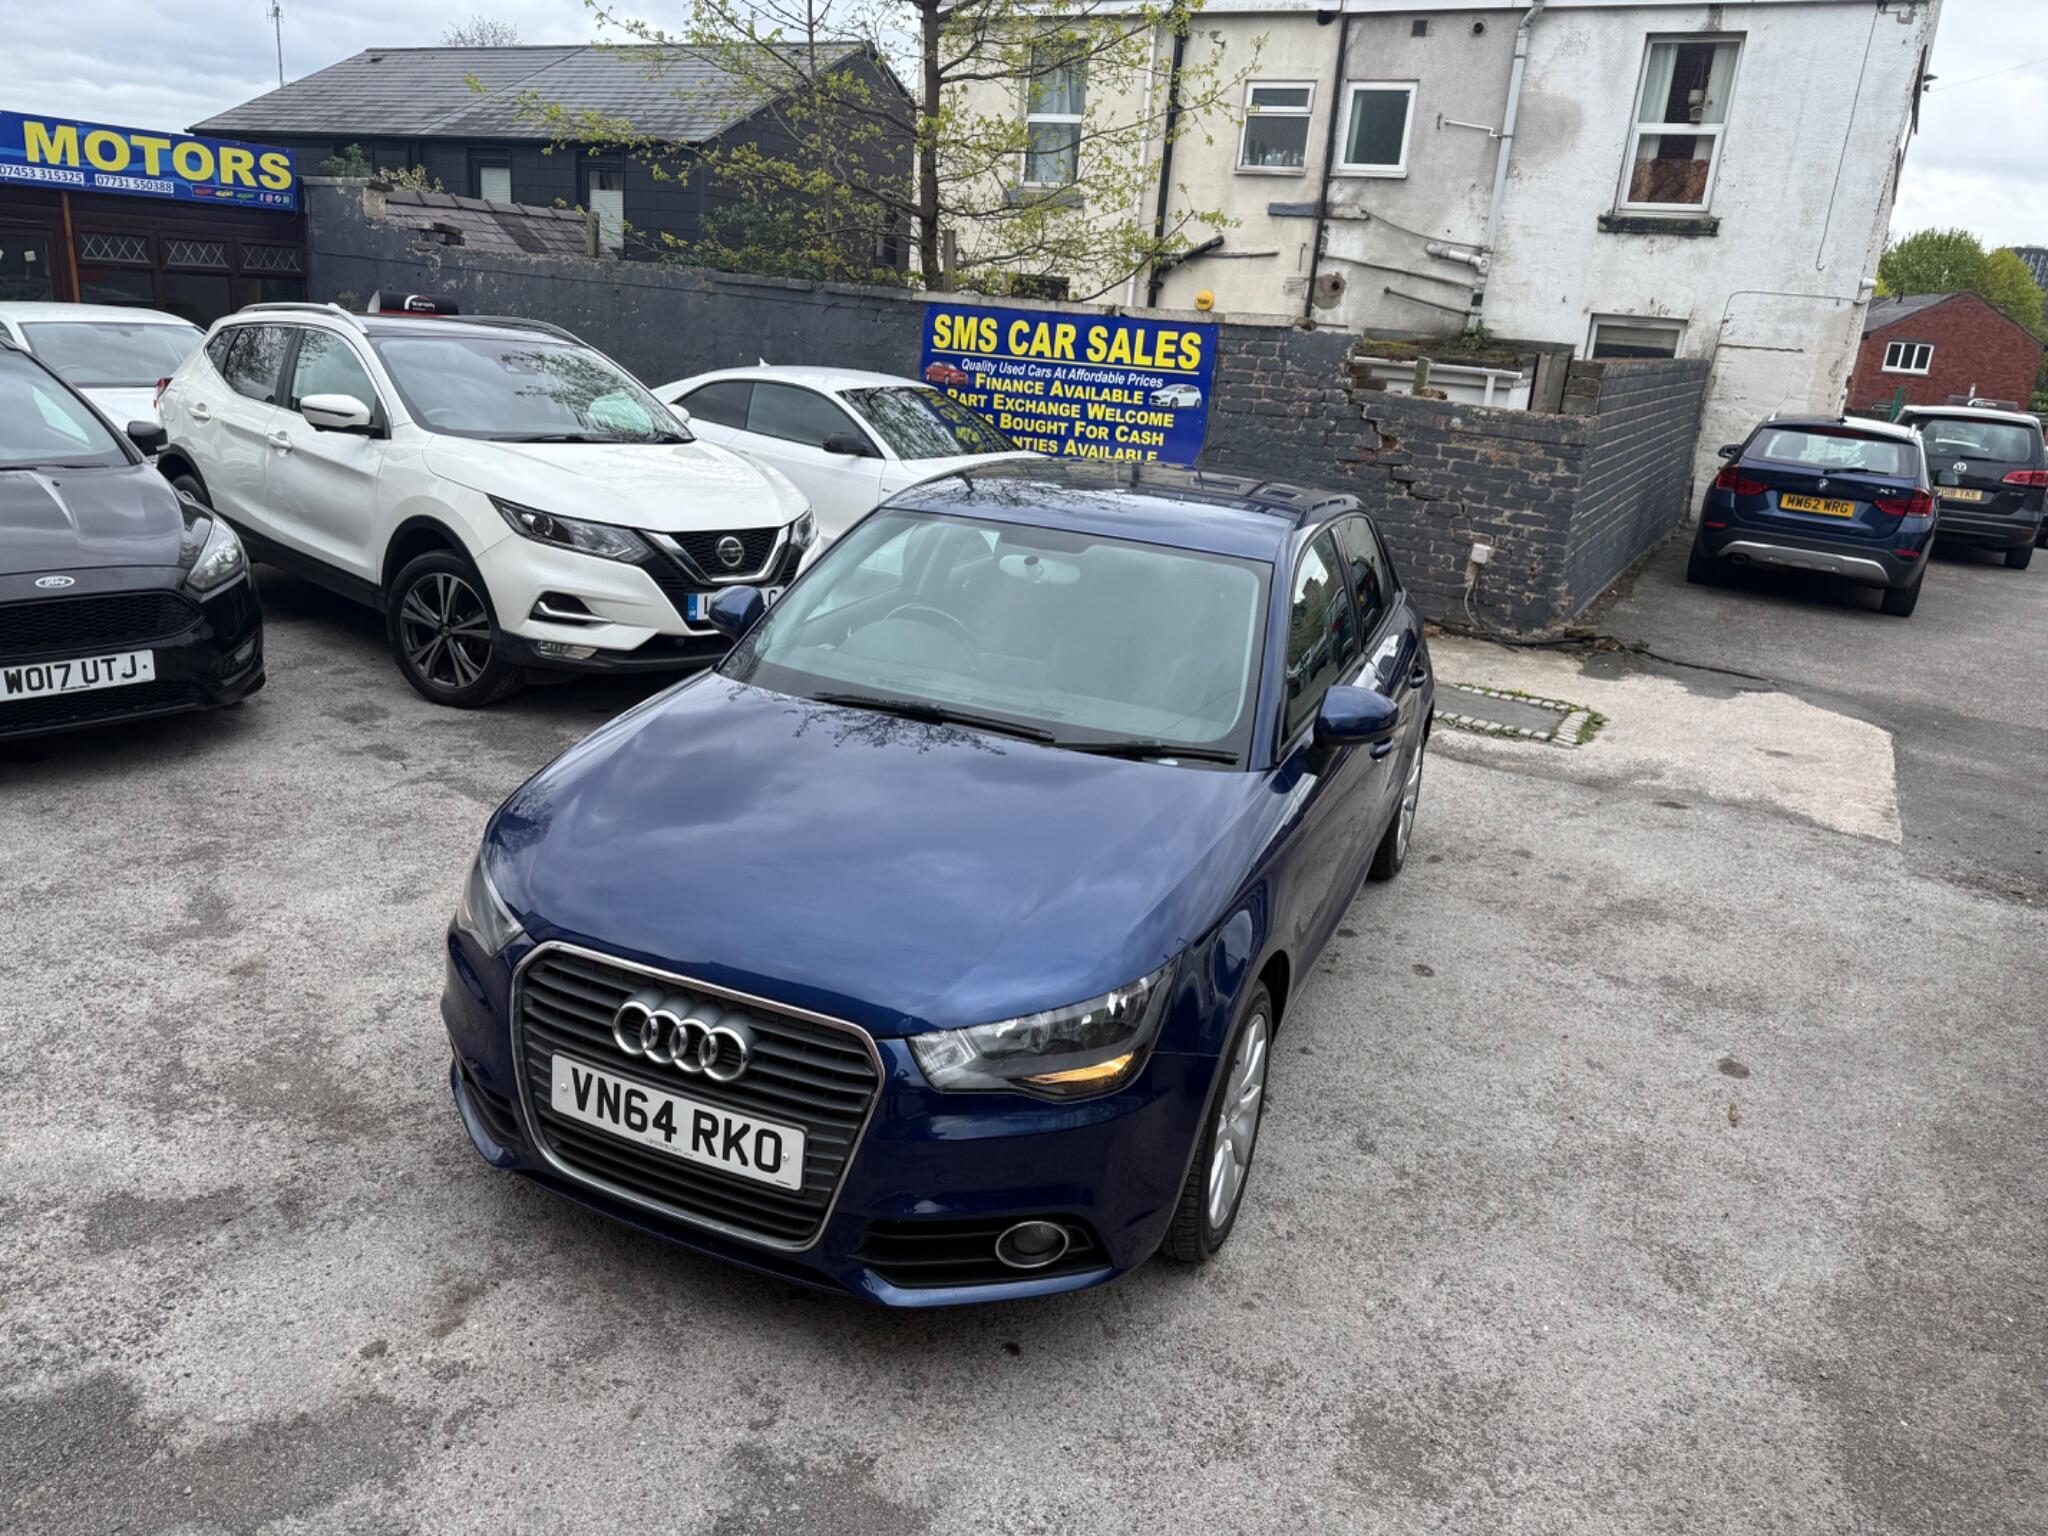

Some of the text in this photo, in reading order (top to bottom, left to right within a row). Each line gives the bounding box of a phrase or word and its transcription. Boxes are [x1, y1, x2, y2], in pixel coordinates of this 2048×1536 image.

[23, 120, 292, 190] MOTORS
[0, 165, 173, 192] 07453 315325 07731 550388
[932, 313, 1202, 371] SMS CAR SALES
[961, 358, 1164, 388] Quality Used Cars At Affordable Prices
[975, 373, 1144, 405] FINANCE AVAILABLE
[947, 388, 988, 408] PART
[993, 393, 1081, 418] EXCHANGE
[1087, 402, 1175, 427] WELCOME
[1000, 412, 1069, 435] BOUGHT
[1074, 420, 1109, 440] FOR
[1115, 425, 1165, 446] CASH
[1012, 435, 1058, 453] NTIES
[1822, 499, 1849, 513] WRG
[4, 655, 137, 694] WO17 UTJ
[571, 1066, 783, 1174] VN64 RKO
